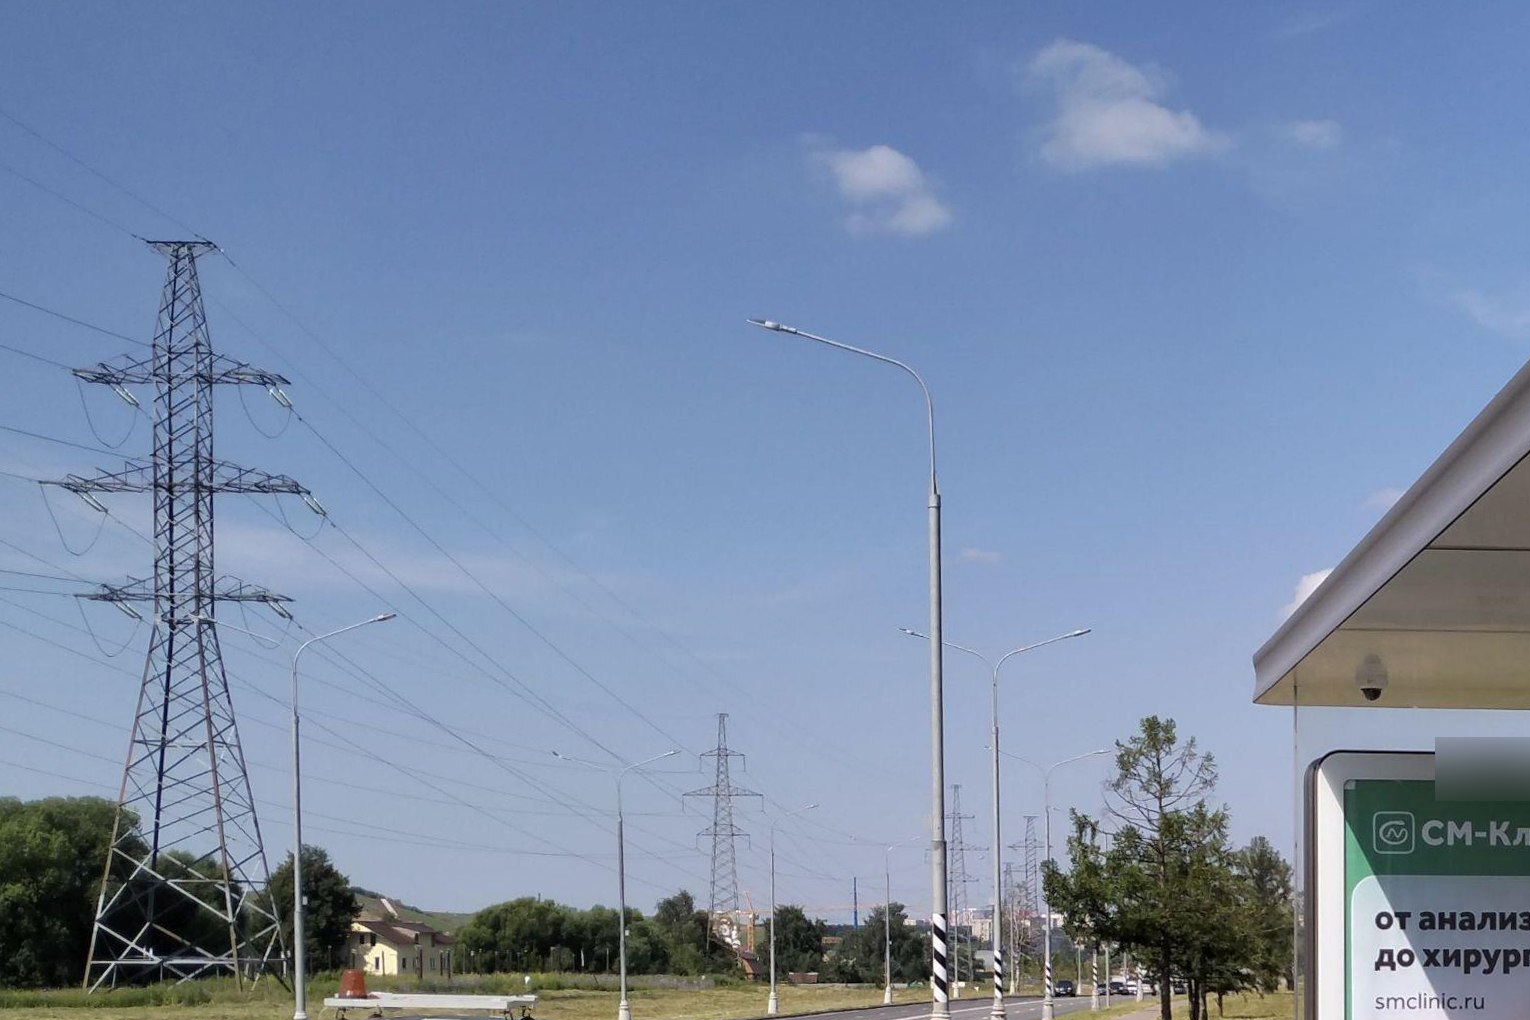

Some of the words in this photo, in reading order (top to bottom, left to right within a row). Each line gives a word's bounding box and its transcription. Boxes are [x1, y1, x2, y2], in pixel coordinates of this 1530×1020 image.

[1374, 911, 1411, 931] от
[1374, 949, 1416, 971] до
[1374, 991, 1486, 1011] smclinic.ru
